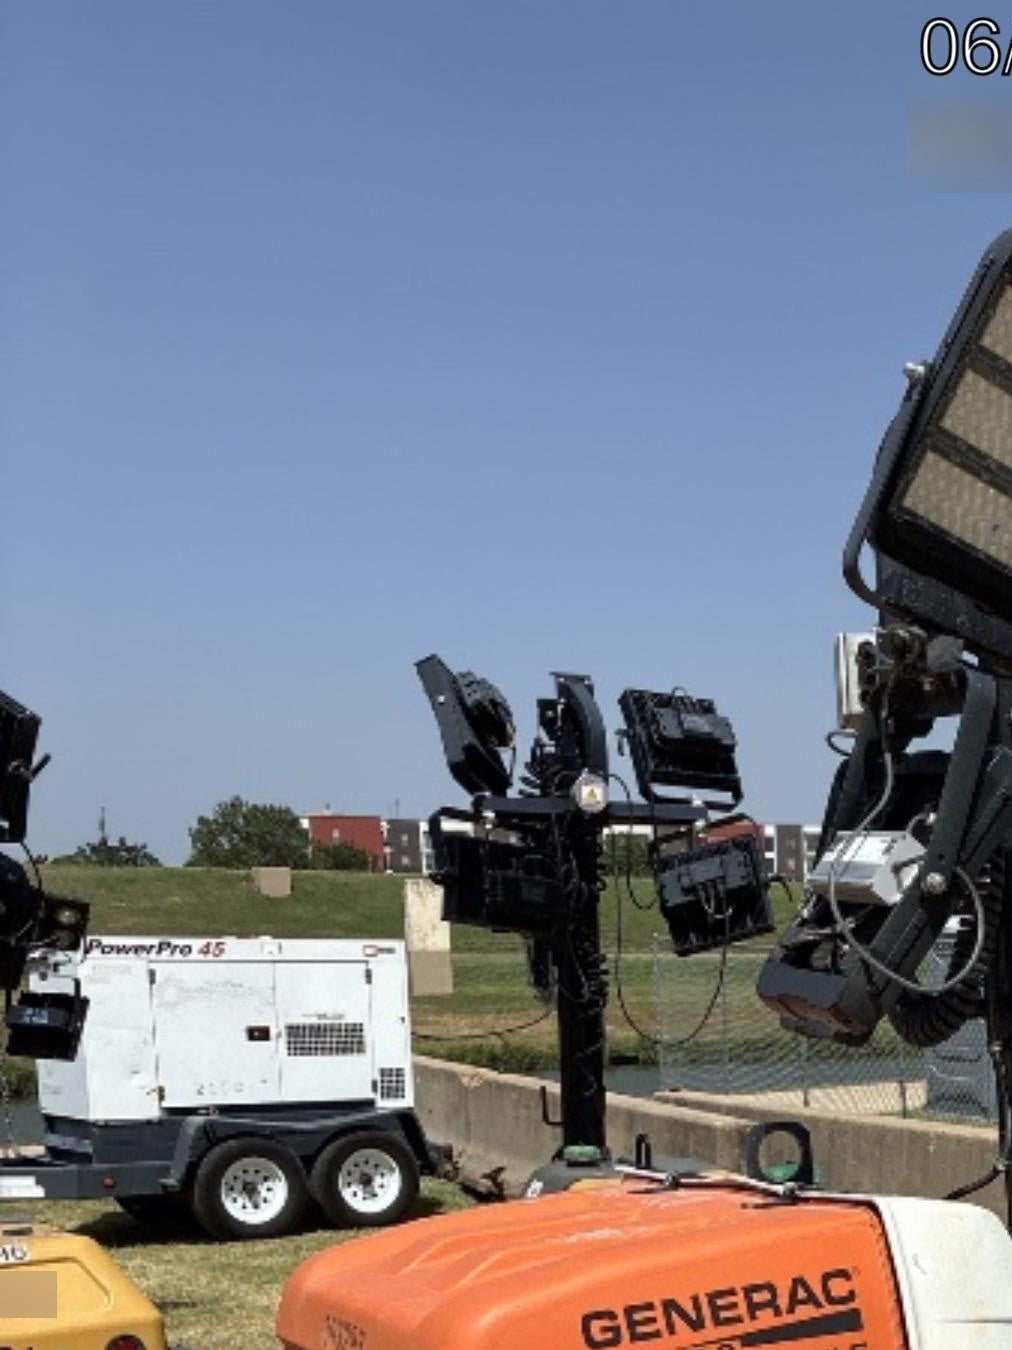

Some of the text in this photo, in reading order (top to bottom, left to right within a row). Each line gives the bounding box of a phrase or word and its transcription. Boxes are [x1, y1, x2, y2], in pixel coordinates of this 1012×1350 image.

[86, 938, 226, 958] PowerPro 45
[581, 1268, 857, 1350] GENERAC
